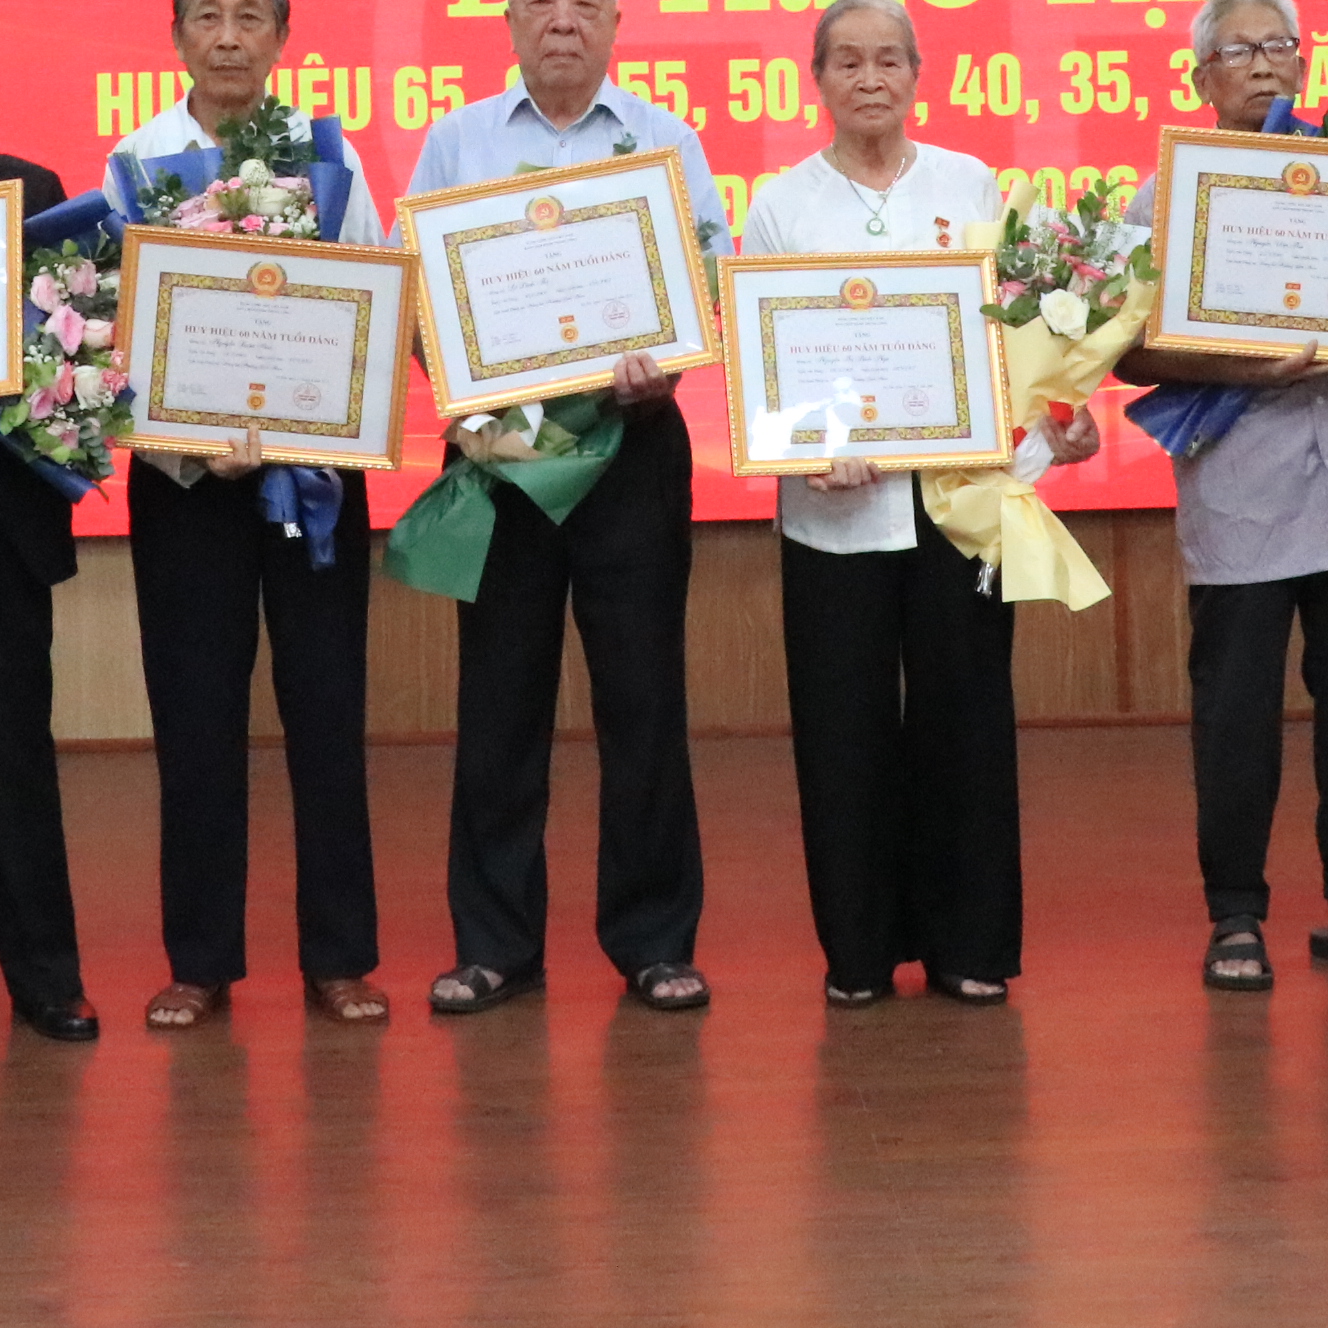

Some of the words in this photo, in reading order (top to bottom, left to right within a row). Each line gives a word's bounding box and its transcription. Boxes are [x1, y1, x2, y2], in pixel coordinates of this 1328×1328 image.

[727, 58, 818, 129] 50,
[950, 52, 1039, 124] 40,
[1060, 50, 1149, 121] 35,
